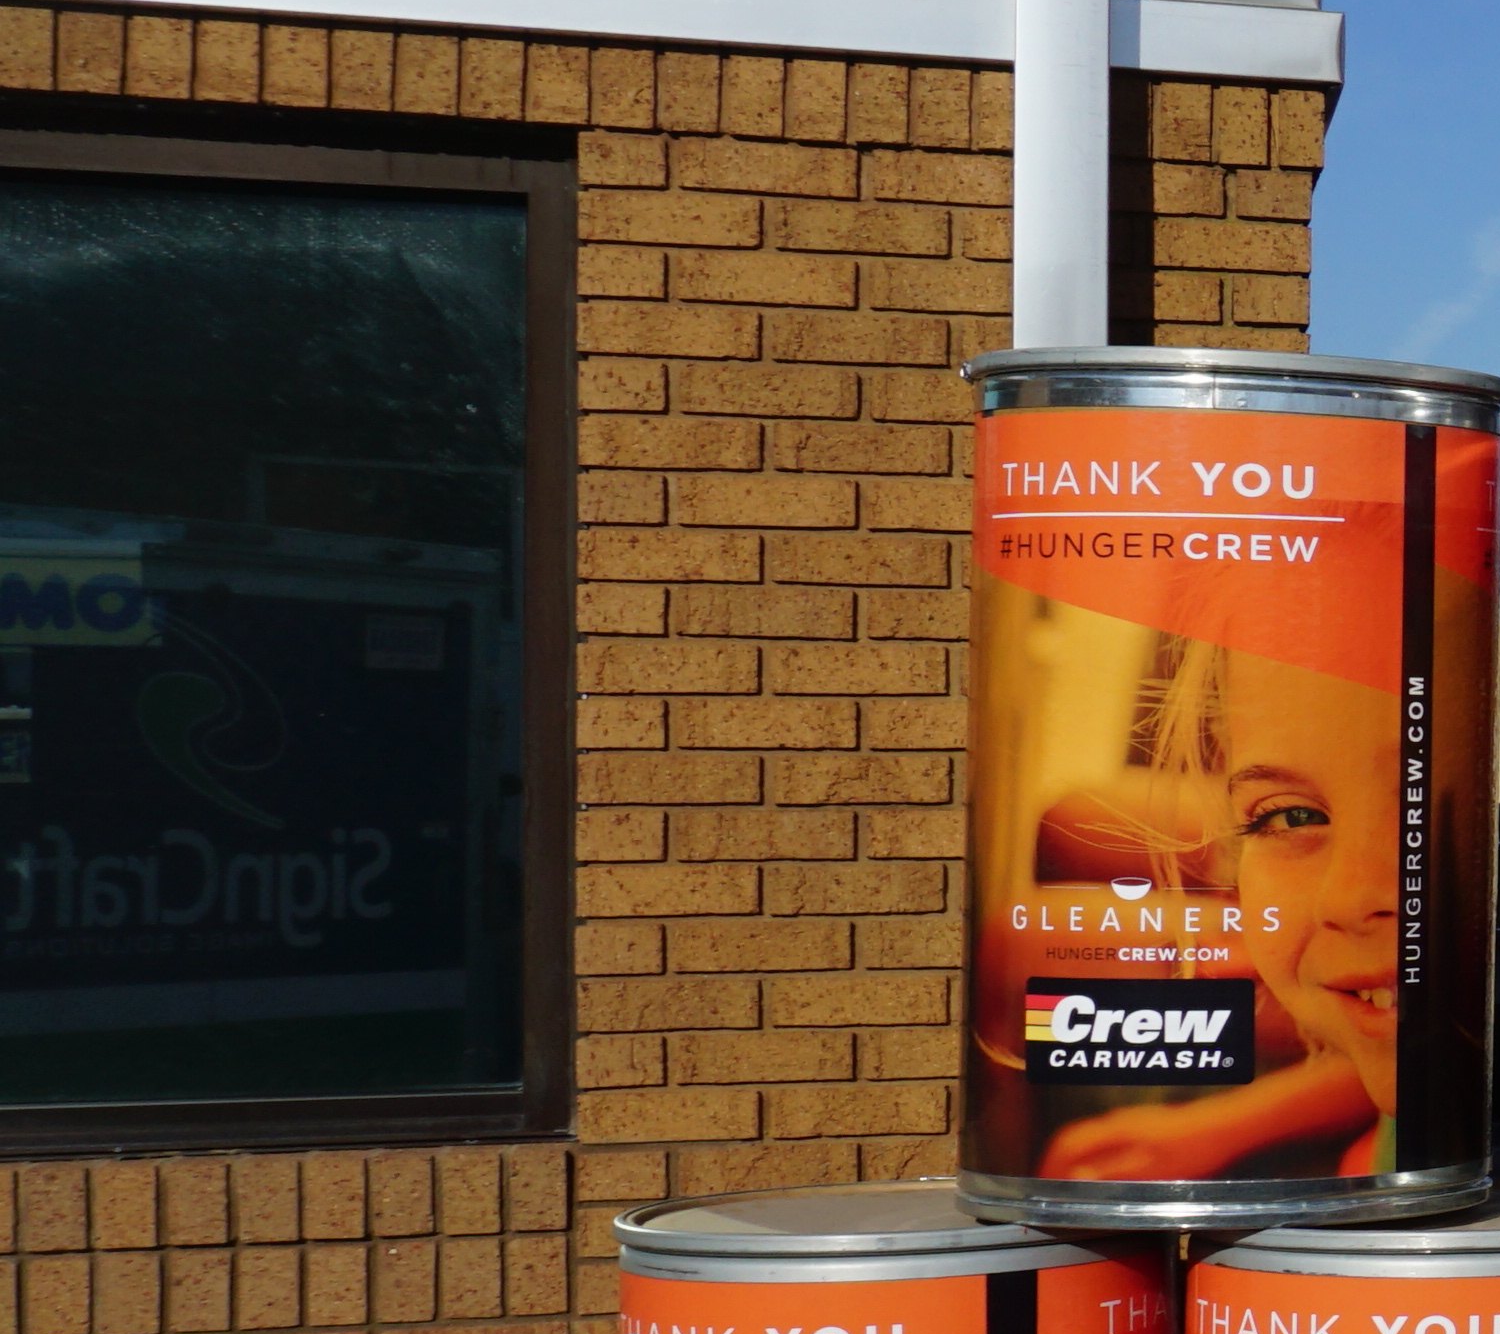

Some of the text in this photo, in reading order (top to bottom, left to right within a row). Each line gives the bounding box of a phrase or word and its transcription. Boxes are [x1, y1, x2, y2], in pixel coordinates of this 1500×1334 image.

[1002, 461, 1315, 499] THANK YOU
[1001, 533, 1319, 563] #HUNGERCREW
[1012, 906, 1280, 932] GLEANERS
[1046, 947, 1229, 962] HUNGERCREW.COM
[1050, 995, 1231, 1044] Crew
